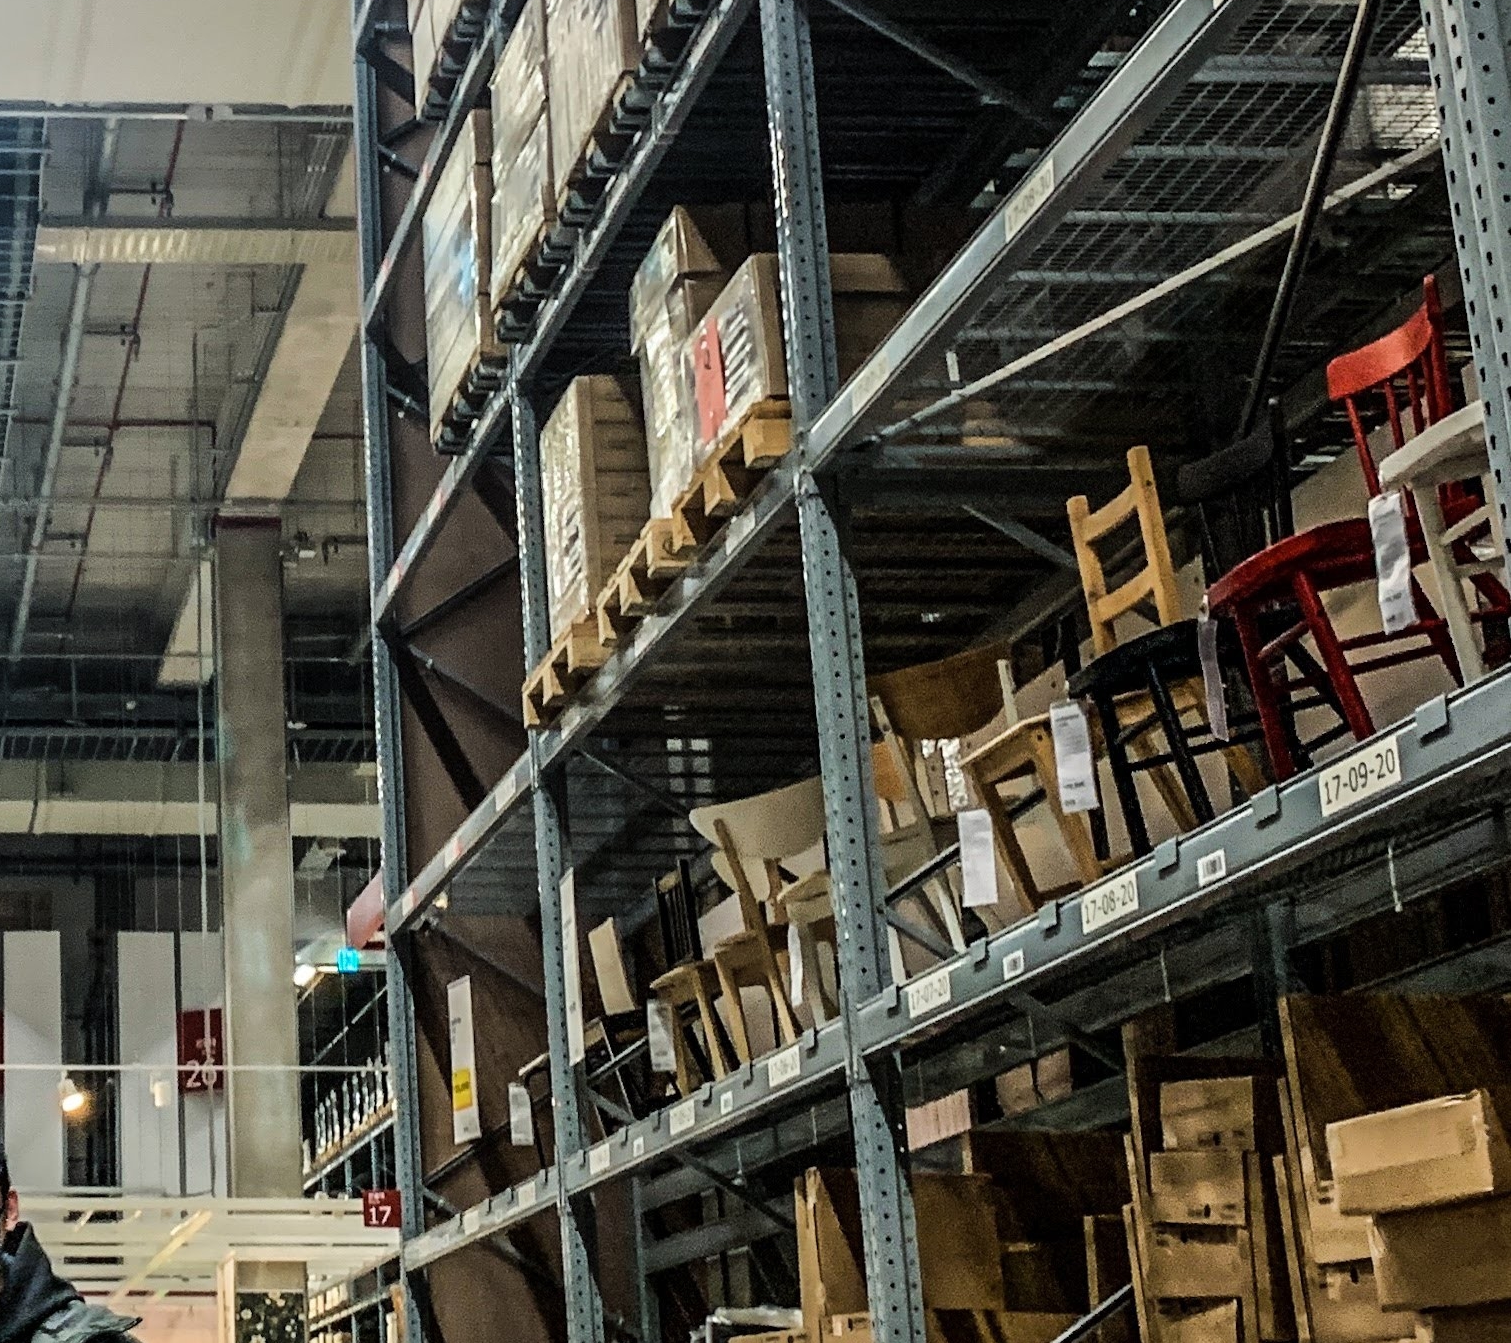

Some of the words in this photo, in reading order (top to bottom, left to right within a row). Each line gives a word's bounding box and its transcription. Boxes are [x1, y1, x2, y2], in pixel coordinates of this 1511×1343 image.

[1007, 168, 1053, 232] 17-08-30
[1324, 748, 1396, 805] 17-09-20
[1084, 880, 1135, 924] 17-08-20
[369, 1205, 392, 1225] 17
